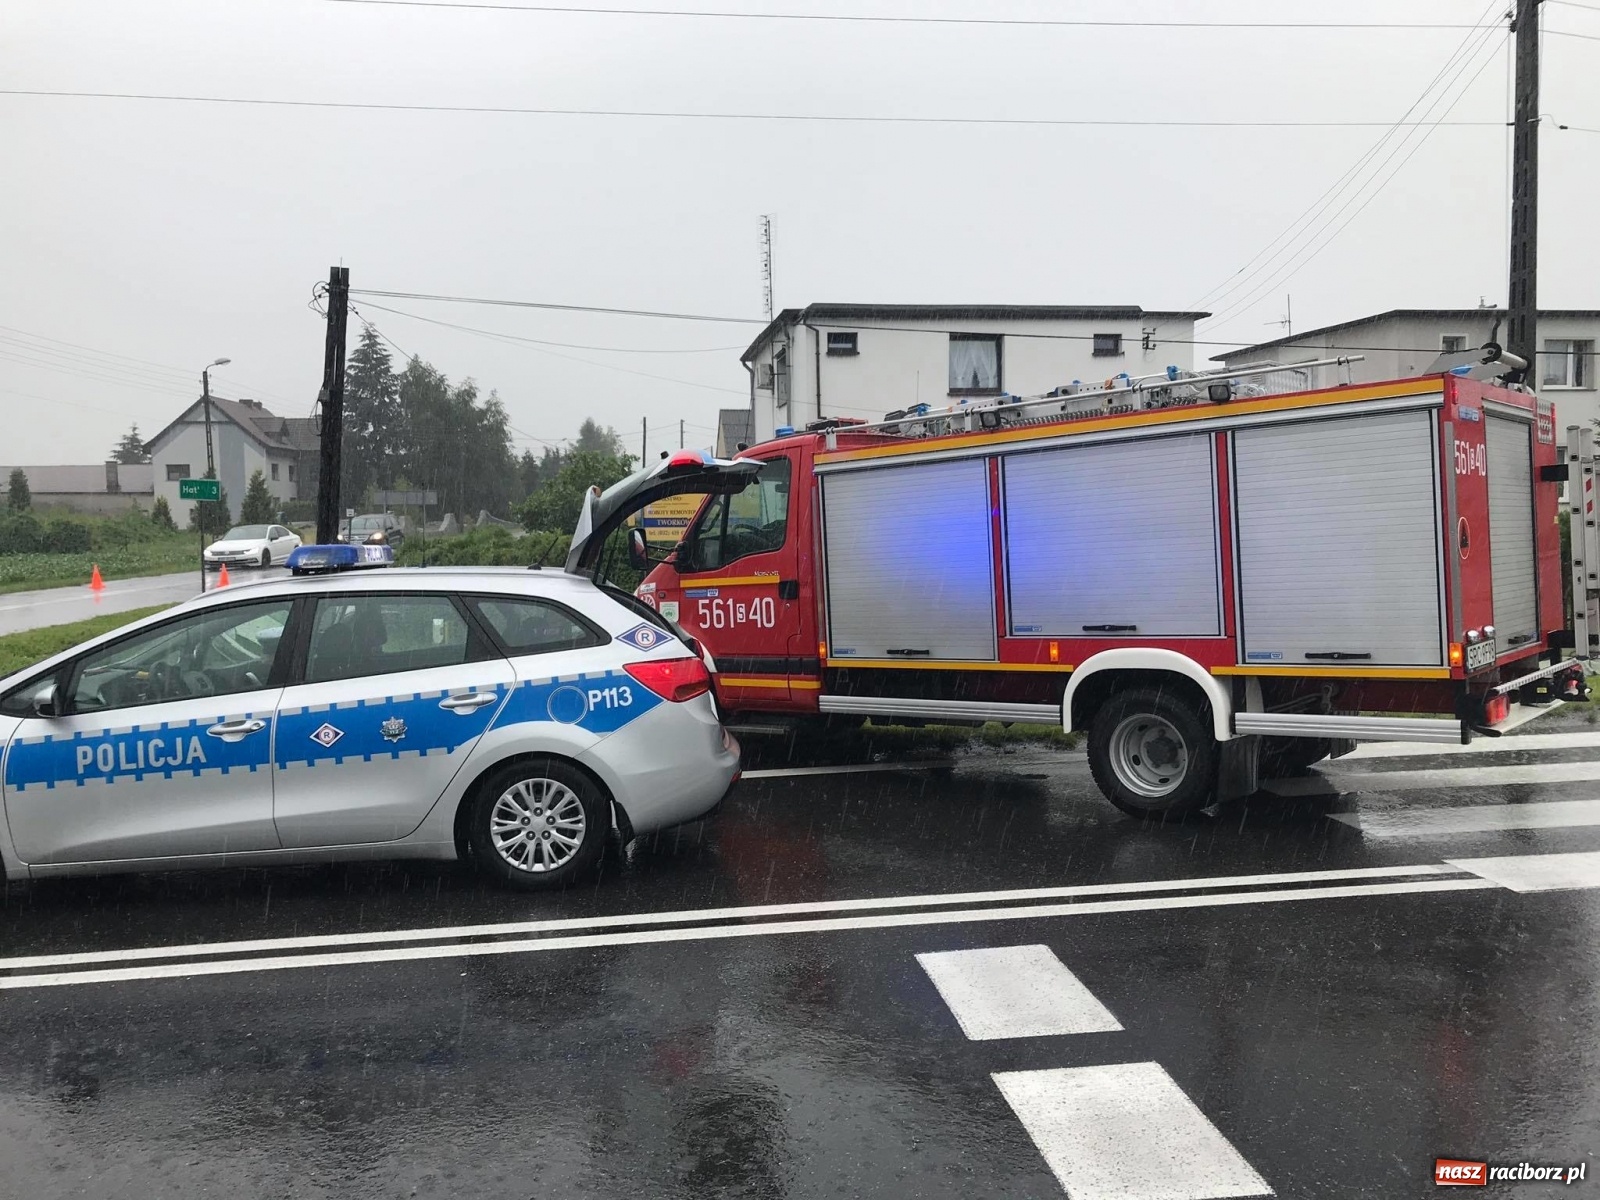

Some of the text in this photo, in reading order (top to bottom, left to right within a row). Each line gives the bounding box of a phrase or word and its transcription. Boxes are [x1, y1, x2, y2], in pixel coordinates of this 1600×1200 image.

[211, 486, 217, 495] 3
[641, 632, 650, 642] R
[588, 685, 633, 711] P113
[323, 731, 331, 739] R
[76, 735, 207, 775] POLICJA
